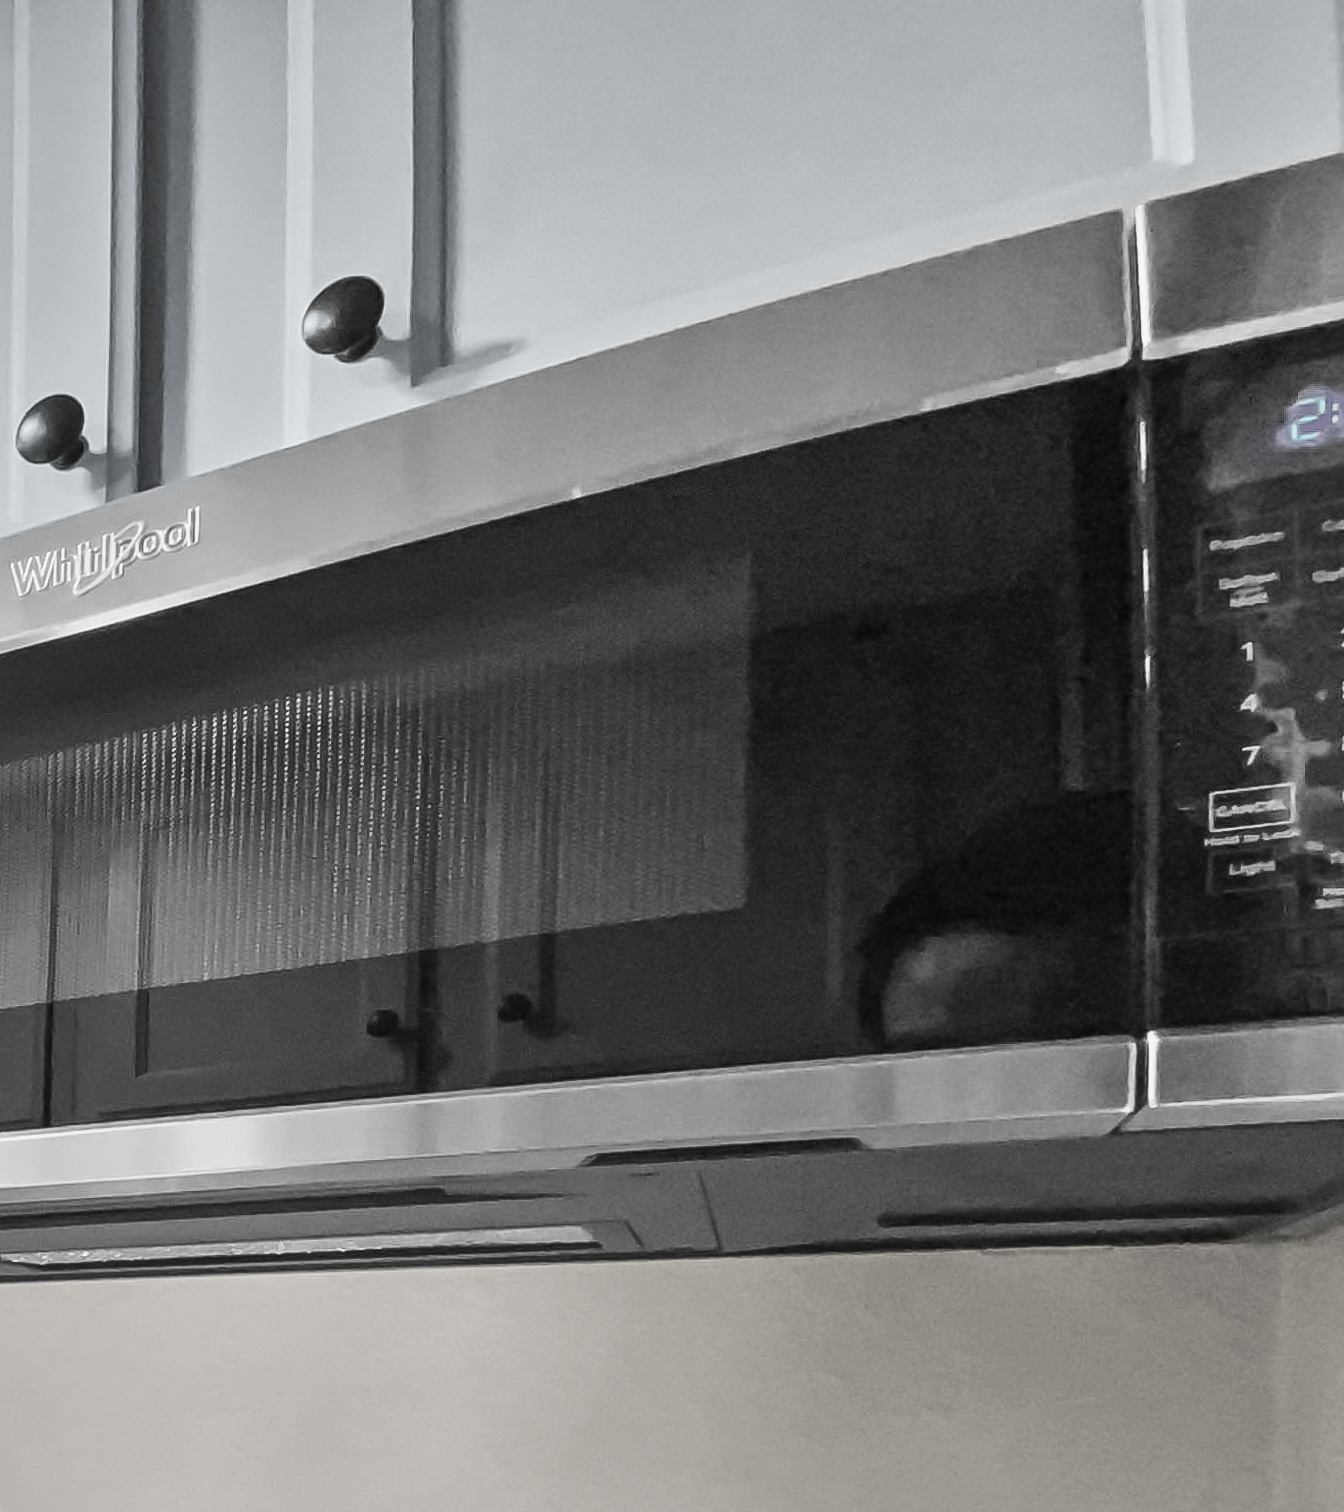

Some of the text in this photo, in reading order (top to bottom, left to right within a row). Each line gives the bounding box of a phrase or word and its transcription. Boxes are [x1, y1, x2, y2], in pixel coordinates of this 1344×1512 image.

[9, 505, 202, 597] Whirlpool
[1240, 641, 1254, 662] 1
[1239, 692, 1258, 712] 4
[1241, 745, 1261, 766] 7
